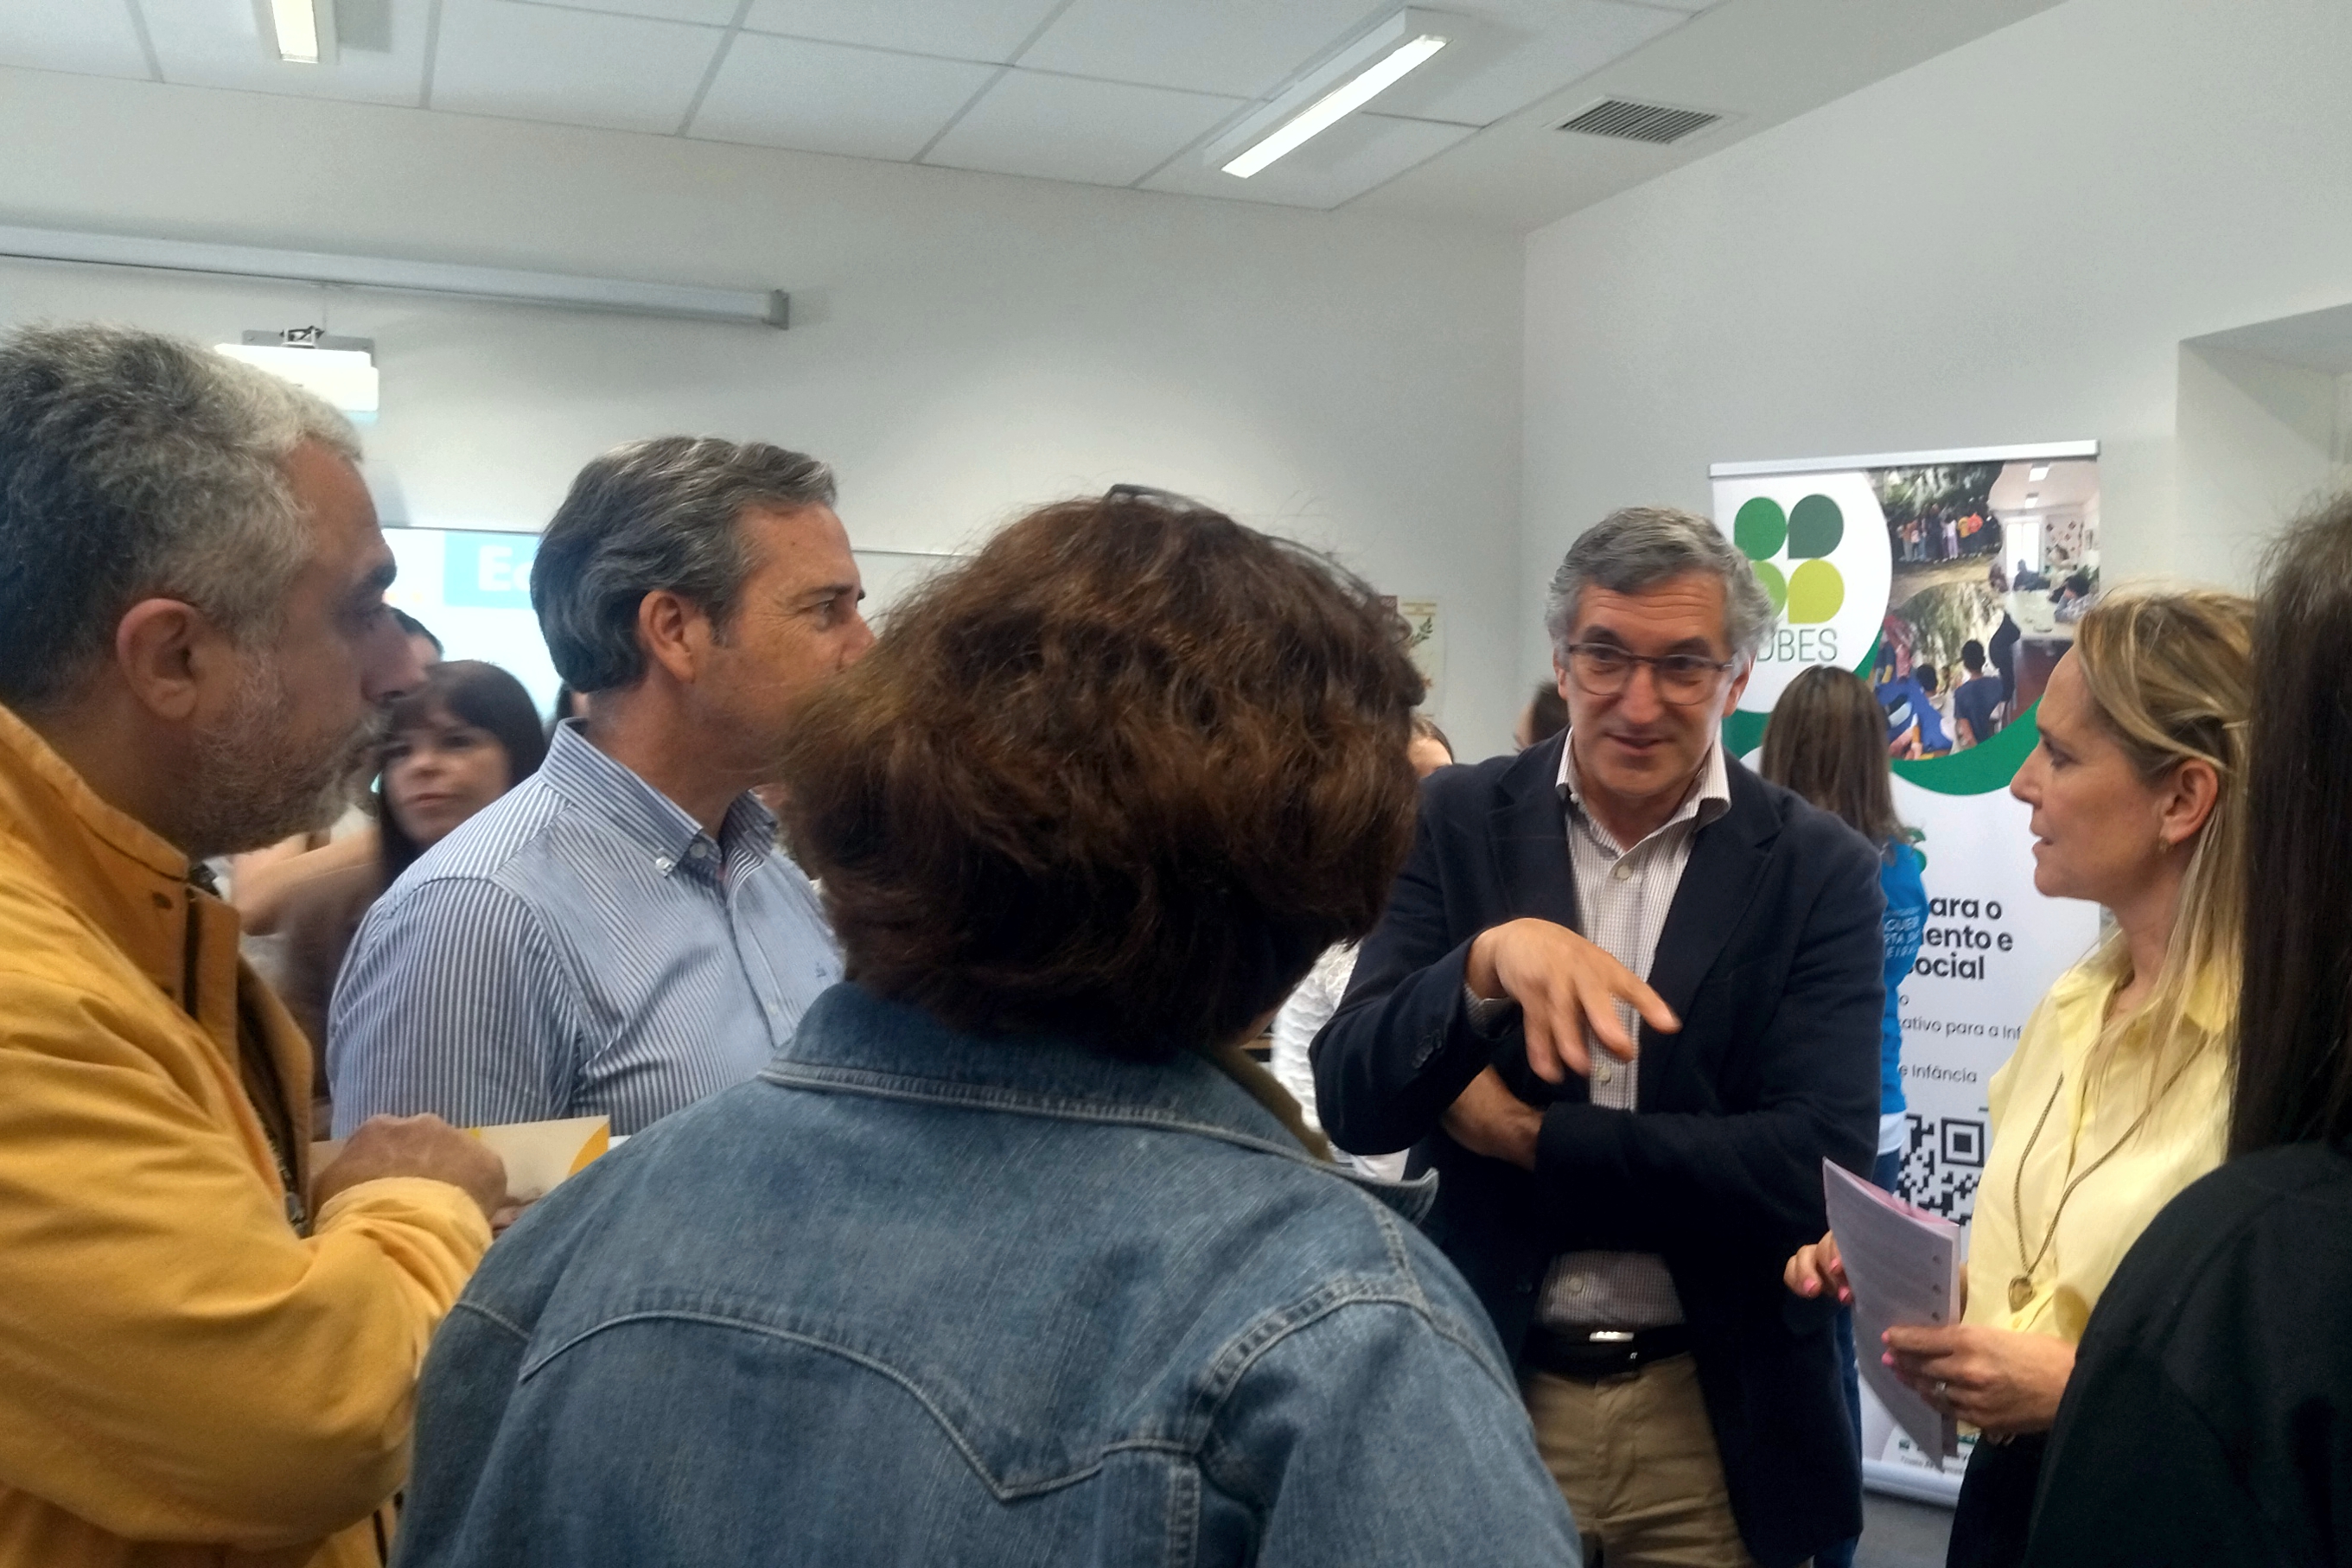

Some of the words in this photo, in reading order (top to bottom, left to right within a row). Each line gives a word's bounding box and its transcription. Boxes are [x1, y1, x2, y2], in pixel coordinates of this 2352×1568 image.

[1985, 901, 2002, 921] o
[1922, 925, 1992, 950] ento
[1997, 932, 2014, 952] e
[1909, 952, 1985, 980] ocial
[1899, 1016, 1942, 1033] ativo
[1946, 1022, 1985, 1038] para
[1989, 1025, 1999, 1037] a
